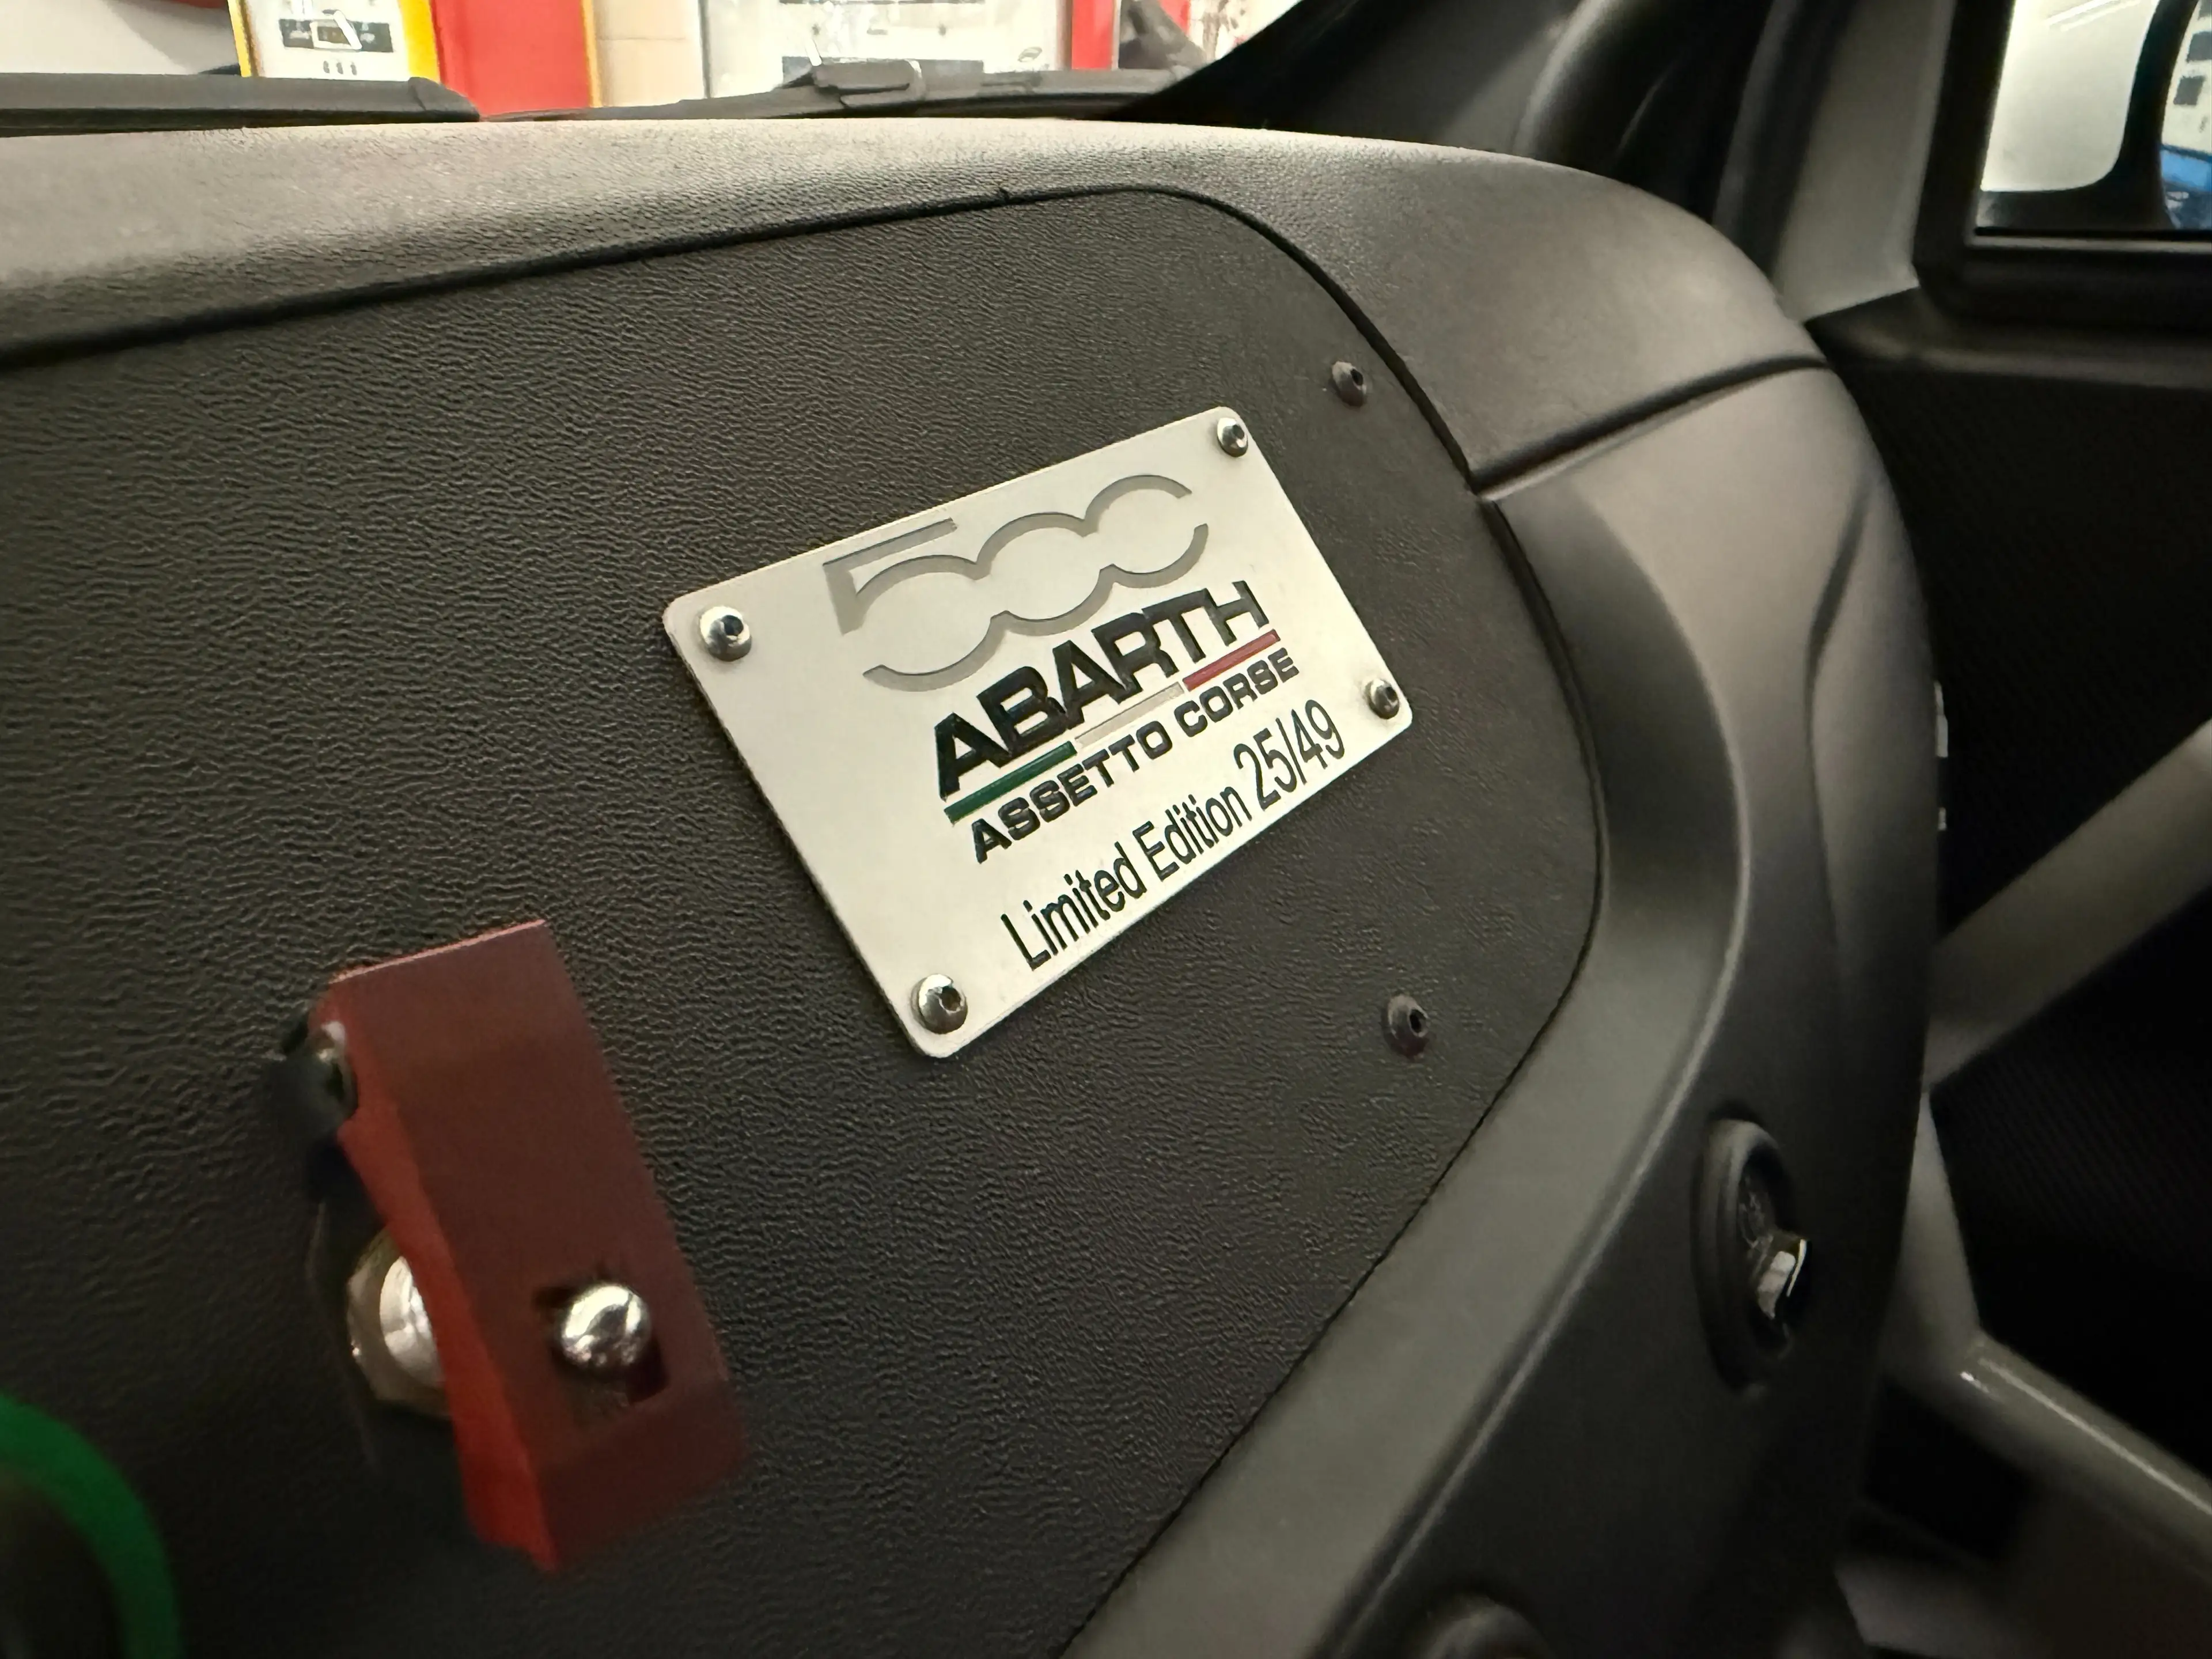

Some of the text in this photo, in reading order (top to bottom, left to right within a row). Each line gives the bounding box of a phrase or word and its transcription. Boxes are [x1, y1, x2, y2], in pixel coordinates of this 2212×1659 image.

[823, 474, 1209, 691] 500
[933, 580, 1269, 800] ABARTH
[971, 646, 1300, 864] ASSETTO CORSE
[1001, 698, 1346, 971] Limited Edition 25/49
